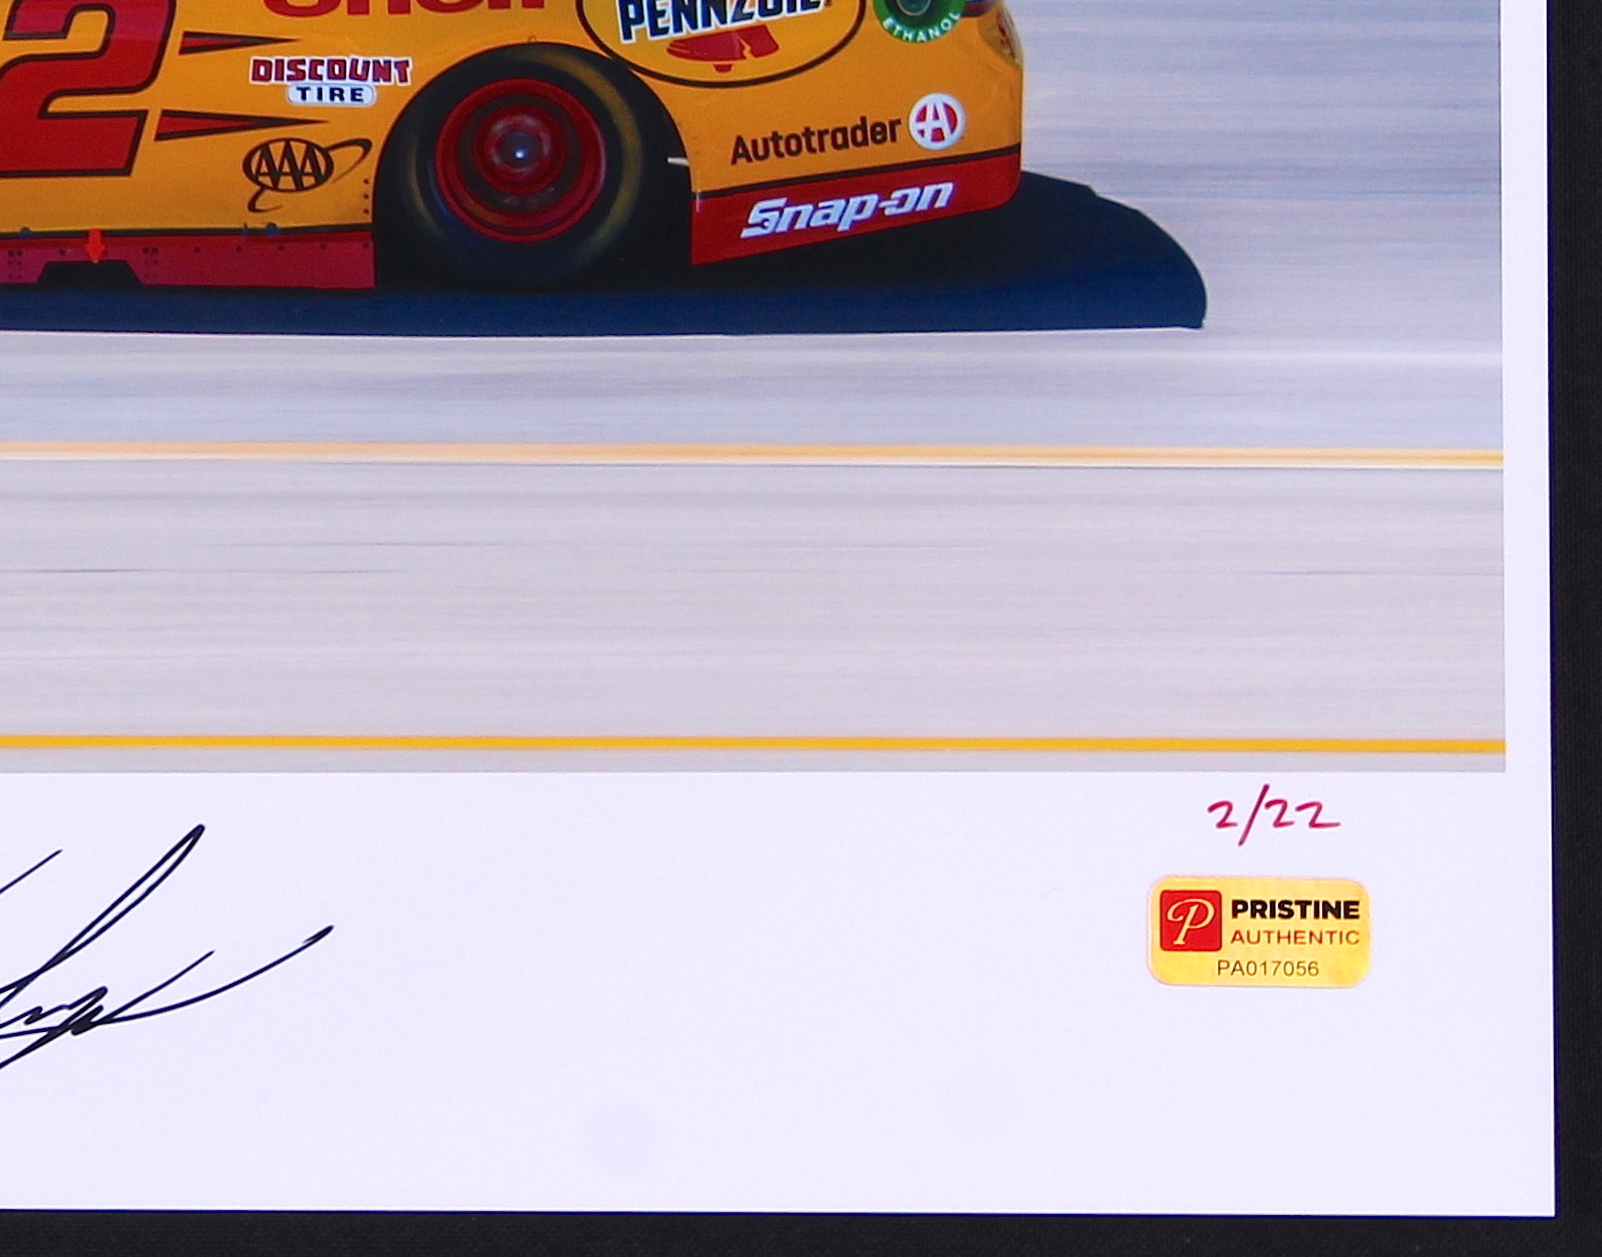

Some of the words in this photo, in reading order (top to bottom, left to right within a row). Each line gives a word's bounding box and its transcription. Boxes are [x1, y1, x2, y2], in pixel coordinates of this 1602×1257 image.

[883, 10, 961, 42] ETHANOL
[251, 57, 410, 84] DISCOUNT
[296, 86, 364, 102] TIRE
[730, 116, 902, 165] Autotrader
[255, 141, 326, 190] AAA
[740, 180, 955, 238] Snap-on
[1207, 784, 1341, 846] 2/22
[1231, 899, 1360, 919] PRISTINE
[1230, 930, 1360, 945] AUTHENTIC
[1217, 960, 1319, 976] PA017056
